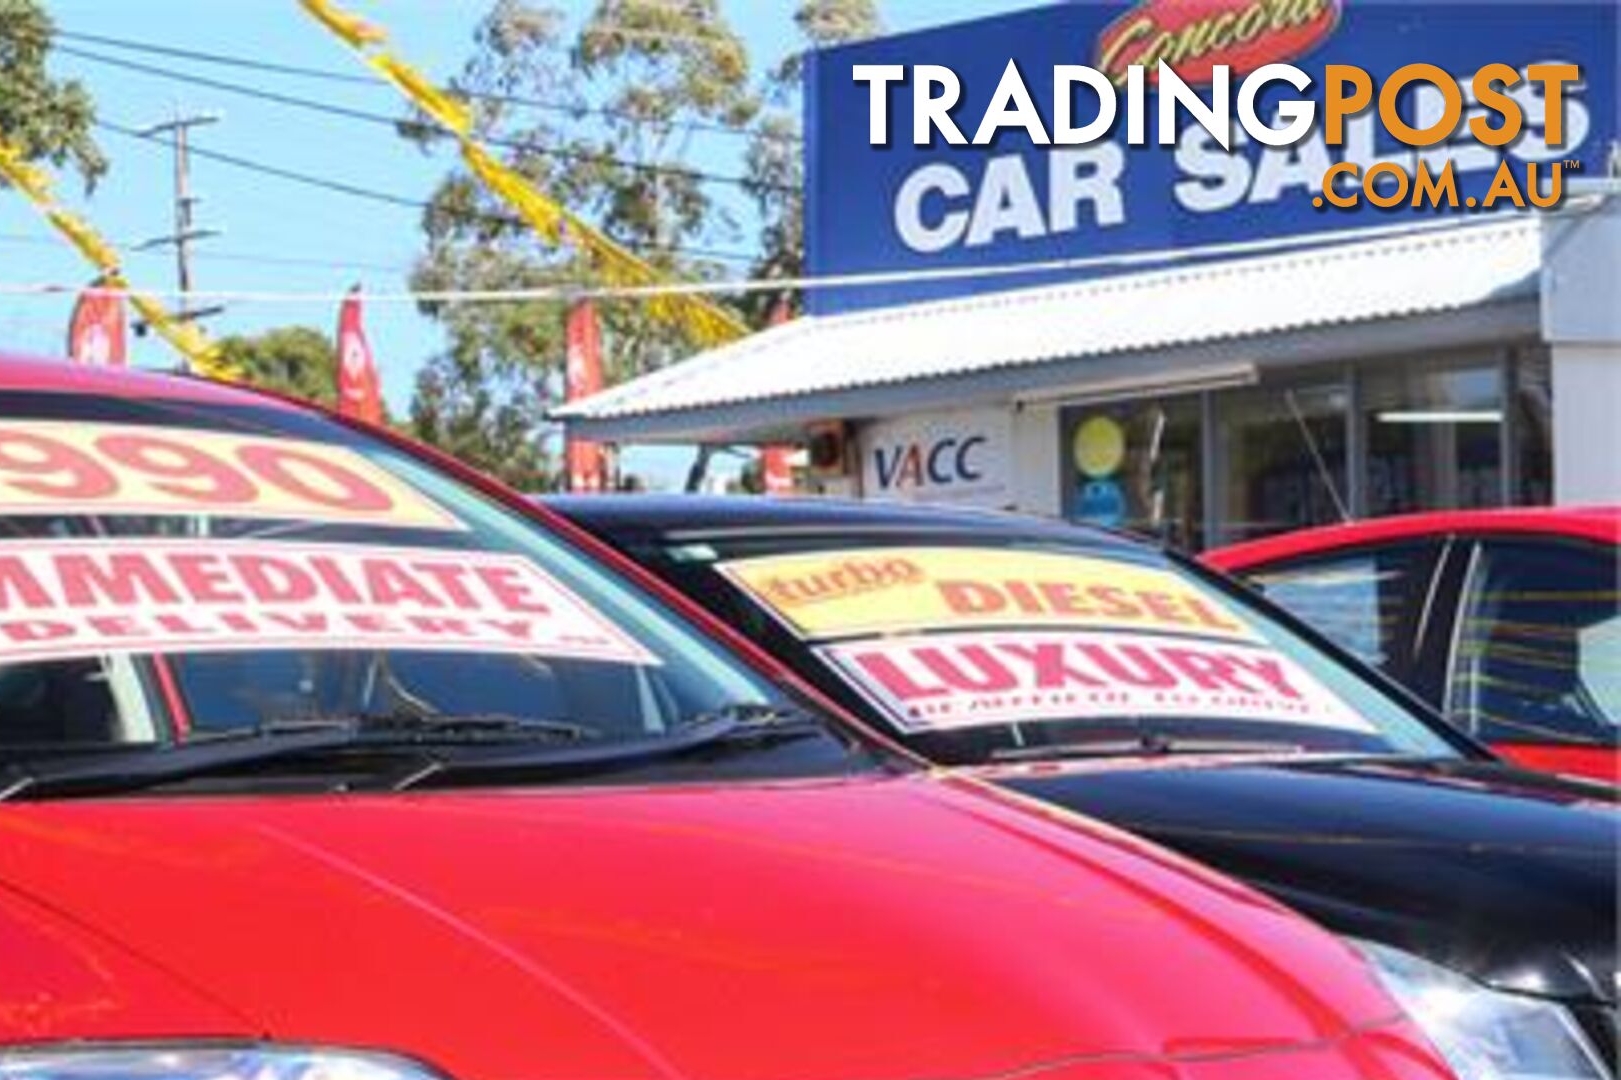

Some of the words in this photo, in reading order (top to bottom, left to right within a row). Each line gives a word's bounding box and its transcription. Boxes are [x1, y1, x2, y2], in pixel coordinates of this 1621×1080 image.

[893, 142, 1126, 252] CAR
[1175, 62, 1590, 212] SALES
[874, 436, 987, 488] VACC
[938, 577, 1240, 632] DIESEL
[854, 642, 1302, 699] LUXURY
